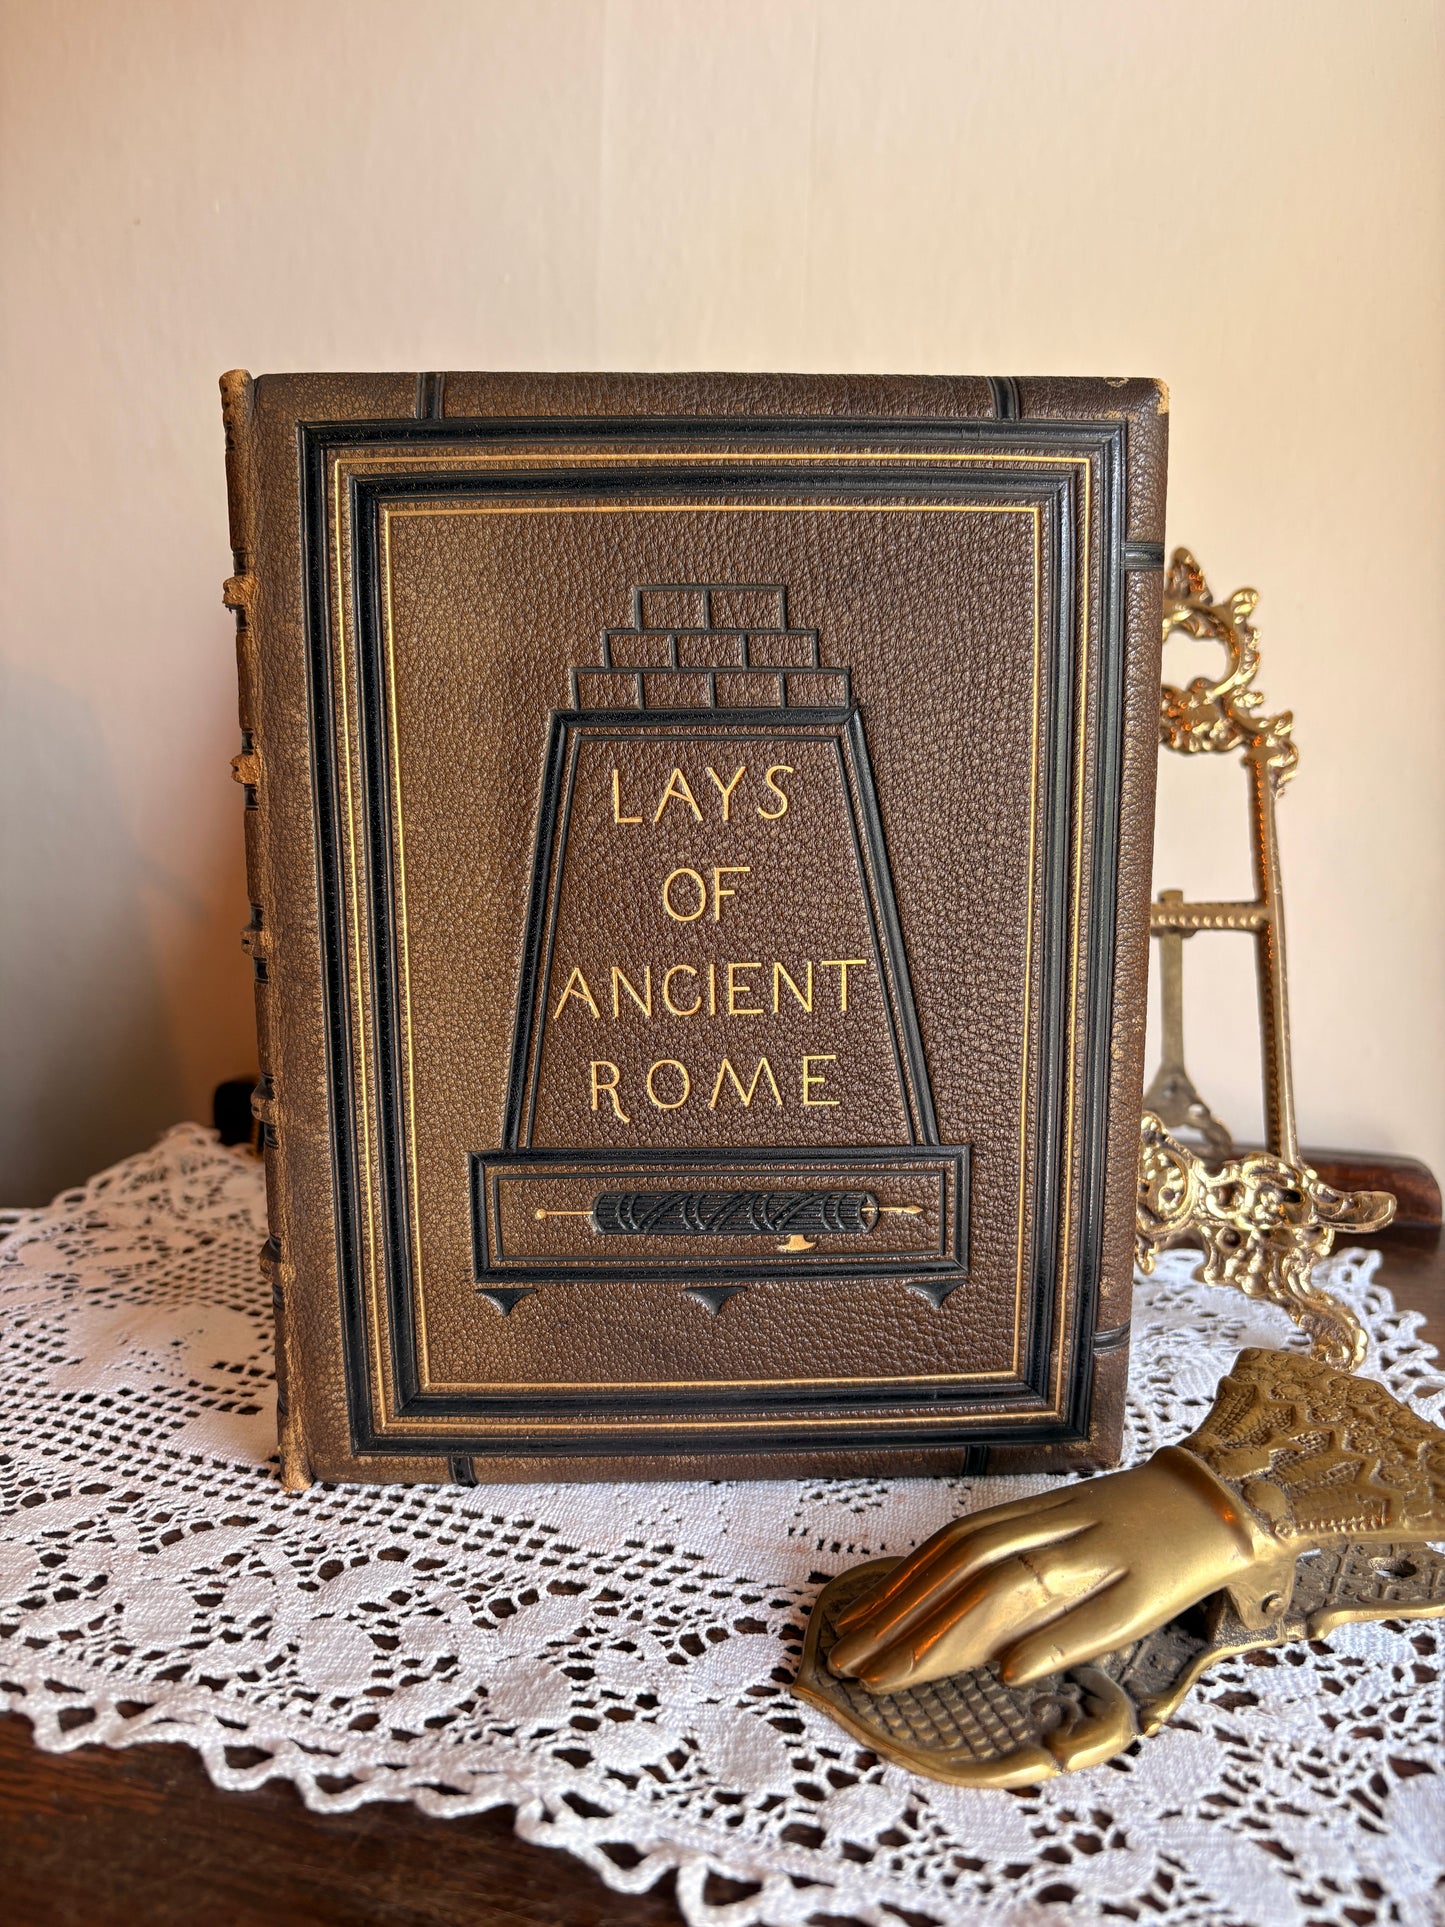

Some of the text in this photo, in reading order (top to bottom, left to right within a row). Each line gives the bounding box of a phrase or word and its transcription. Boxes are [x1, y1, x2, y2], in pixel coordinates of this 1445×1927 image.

[612, 765, 795, 824] LAYS
[663, 866, 751, 922] OF
[553, 959, 867, 1019] ANCIENT
[590, 1054, 841, 1123] ROME
